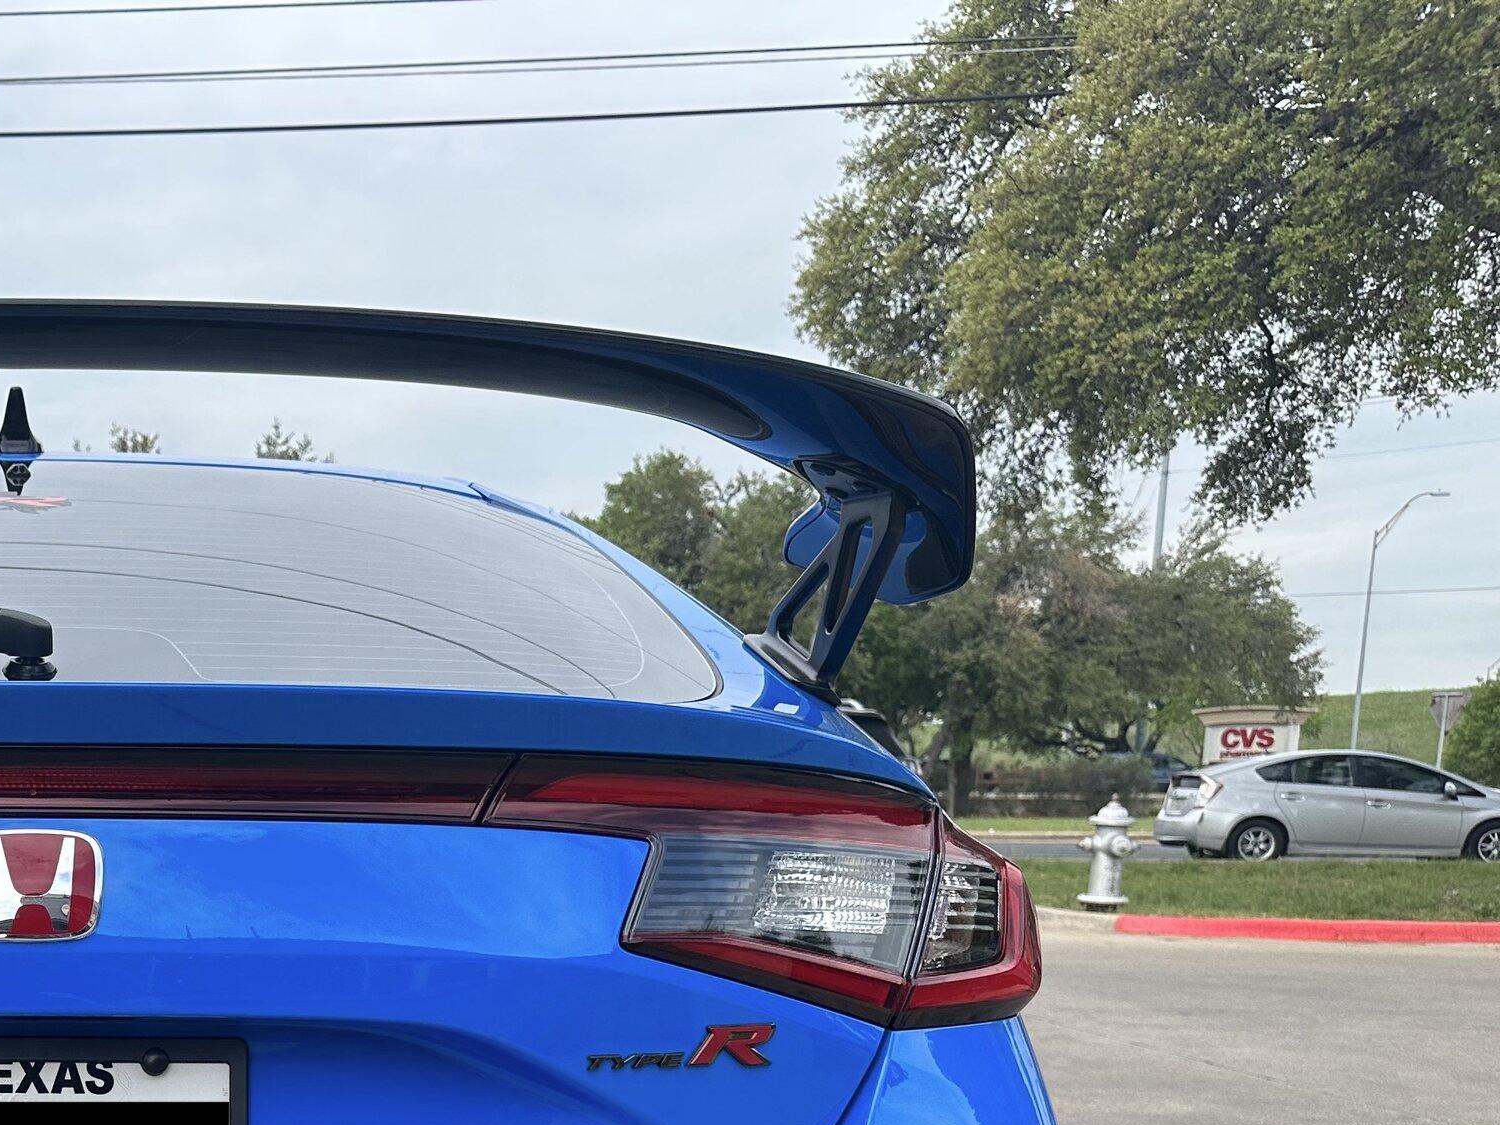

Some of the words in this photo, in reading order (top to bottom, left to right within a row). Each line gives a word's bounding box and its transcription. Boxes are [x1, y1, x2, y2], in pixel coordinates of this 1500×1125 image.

[1221, 728, 1275, 748] CVS
[587, 1052, 684, 1071] TYPE
[685, 1022, 776, 1067] R
